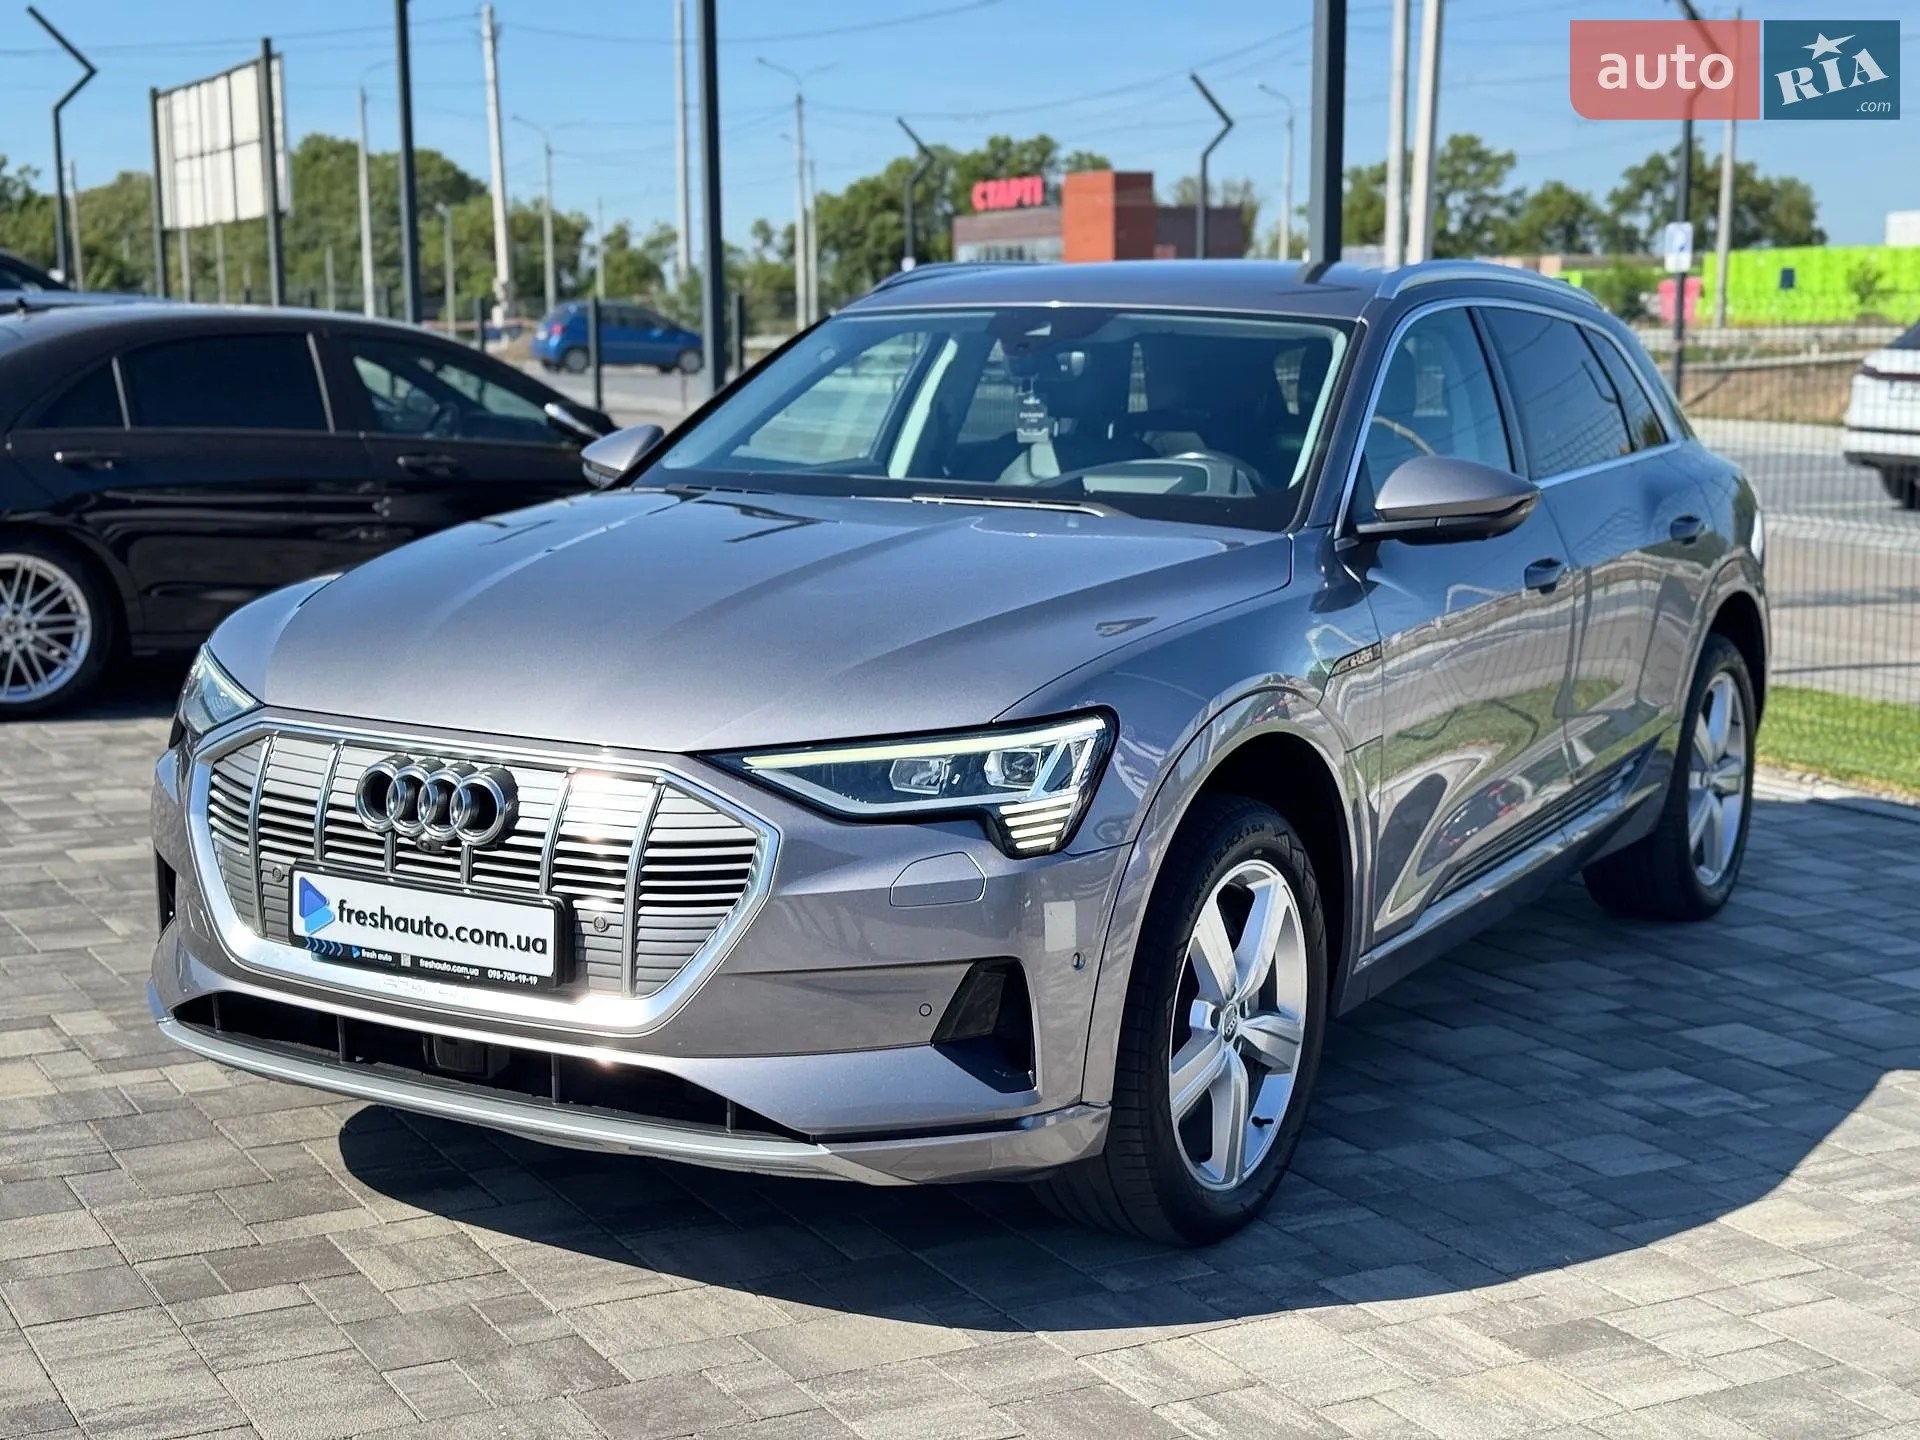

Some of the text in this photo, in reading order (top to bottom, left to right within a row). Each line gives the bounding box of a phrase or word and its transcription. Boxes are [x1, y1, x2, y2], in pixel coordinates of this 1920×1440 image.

[338, 898, 548, 955] freshauto.com.ua
[361, 948, 393, 962] fresh auto
[419, 958, 480, 977] freshauto.com.ua
